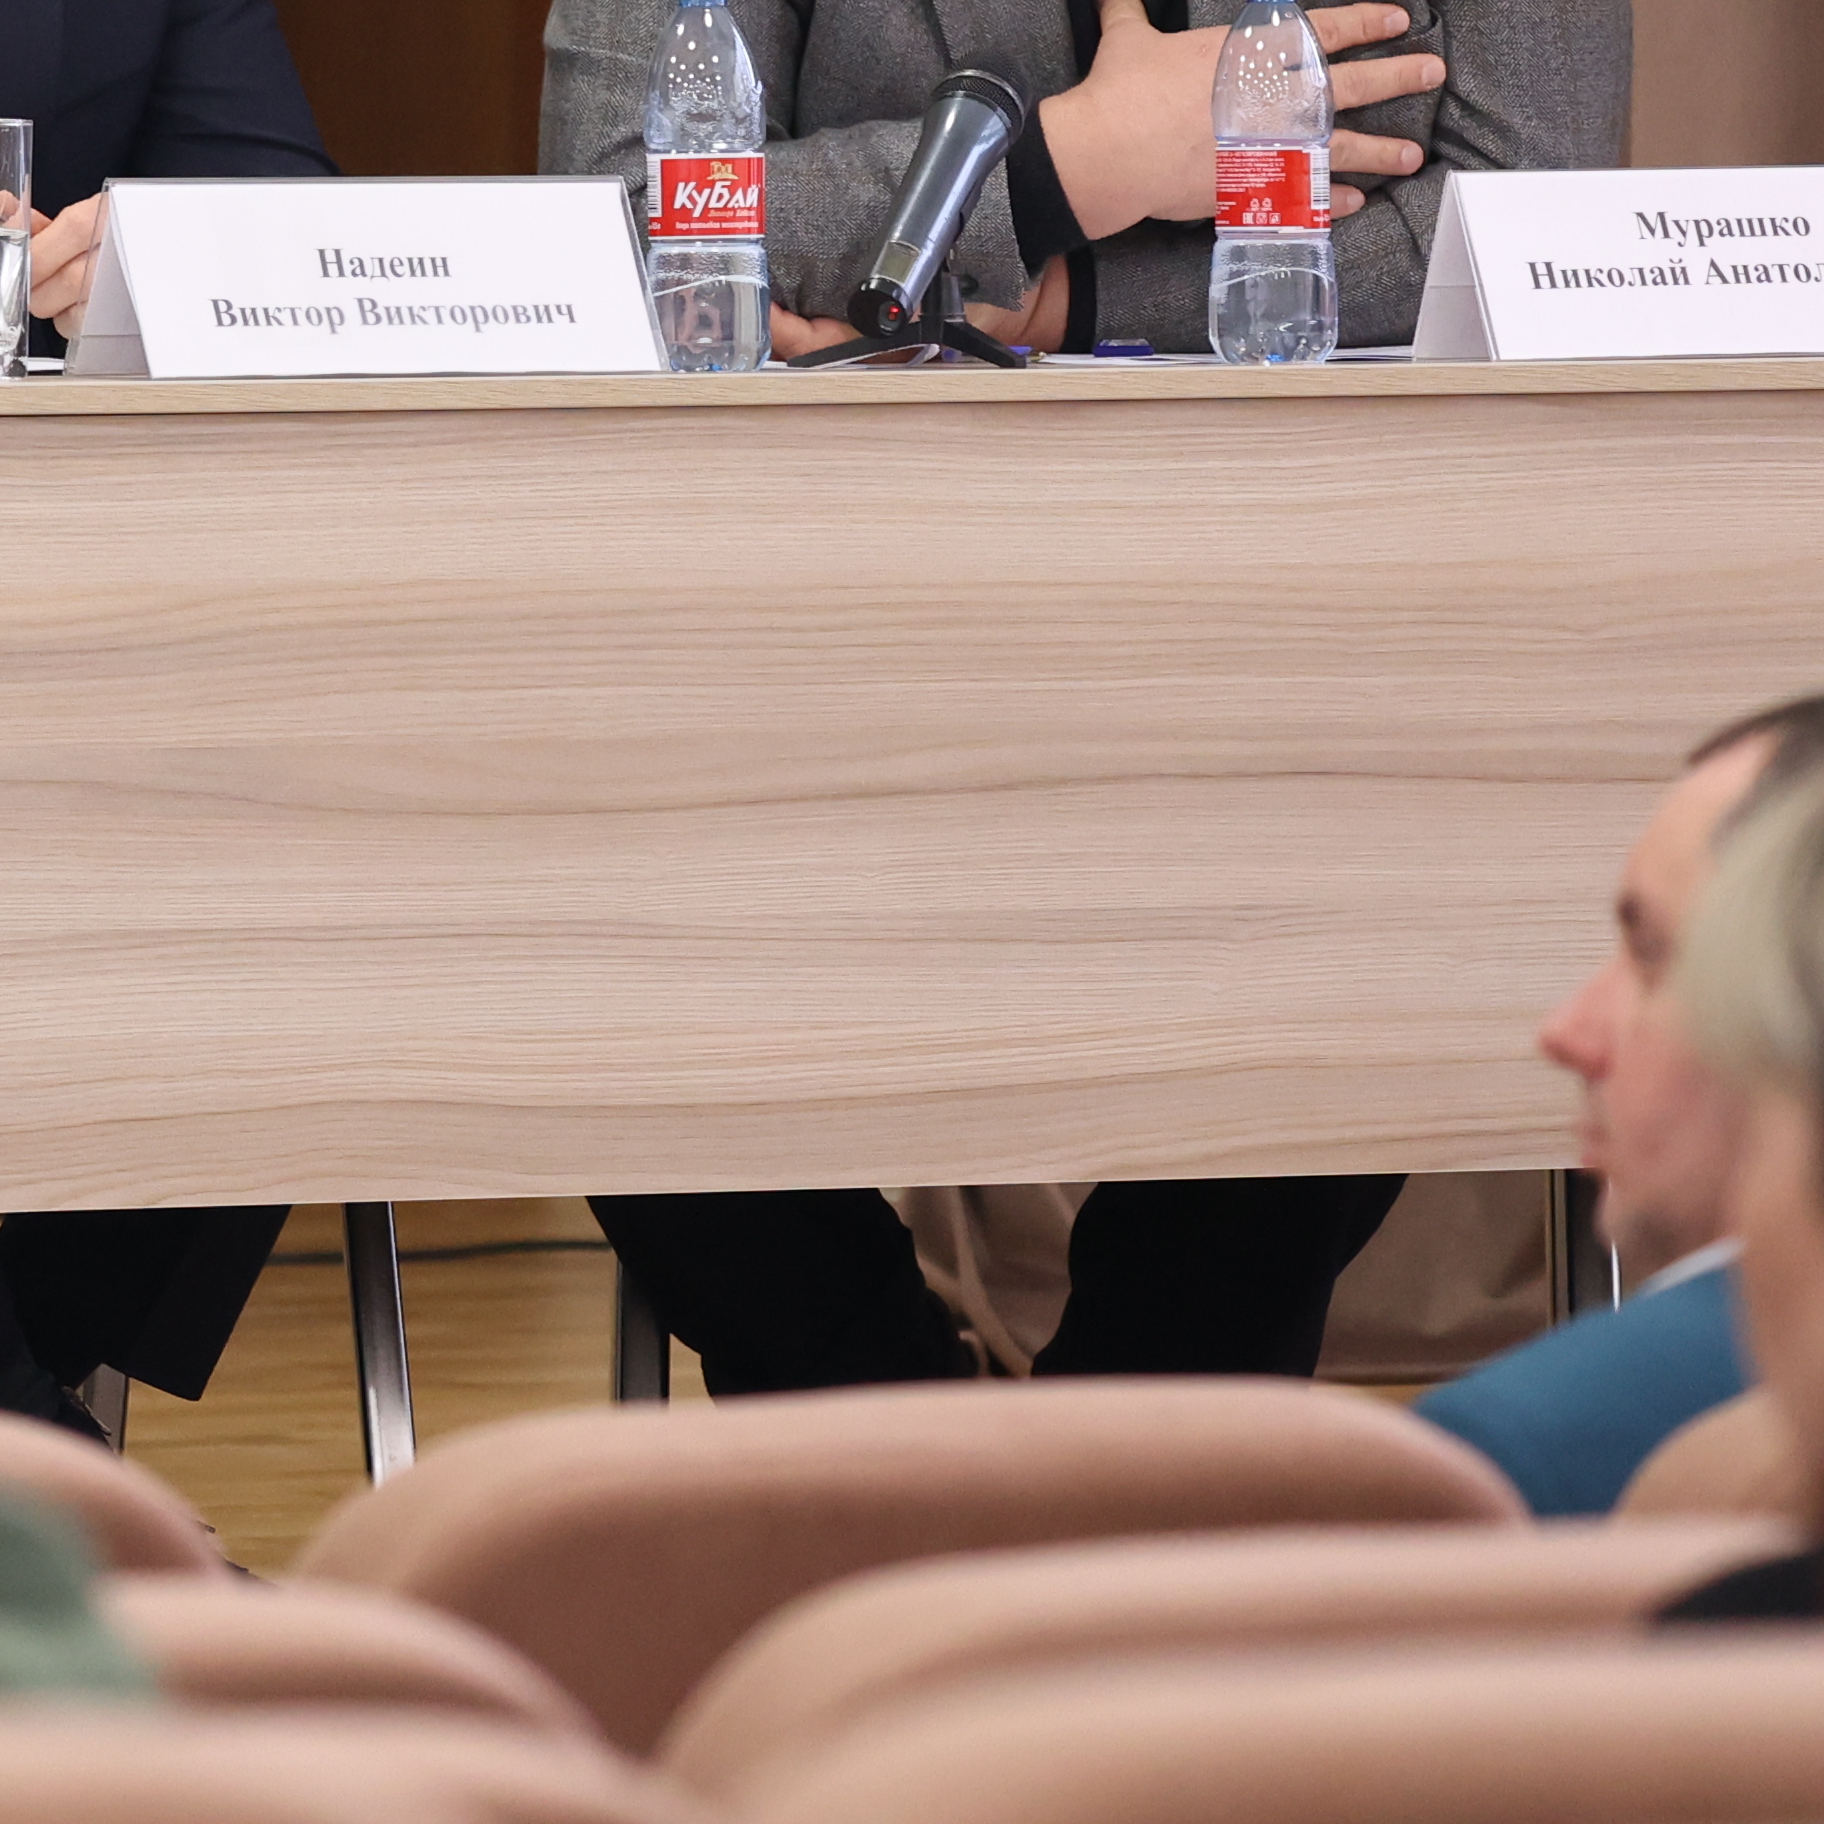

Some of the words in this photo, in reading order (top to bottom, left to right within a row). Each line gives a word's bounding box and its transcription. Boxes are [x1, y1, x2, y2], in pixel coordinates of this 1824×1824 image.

[1632, 210, 1812, 248] Мурашко
[315, 247, 452, 281] Надеин
[1526, 257, 1693, 291] Николай
[209, 297, 346, 336] Виктор
[354, 297, 578, 334] Викторович
